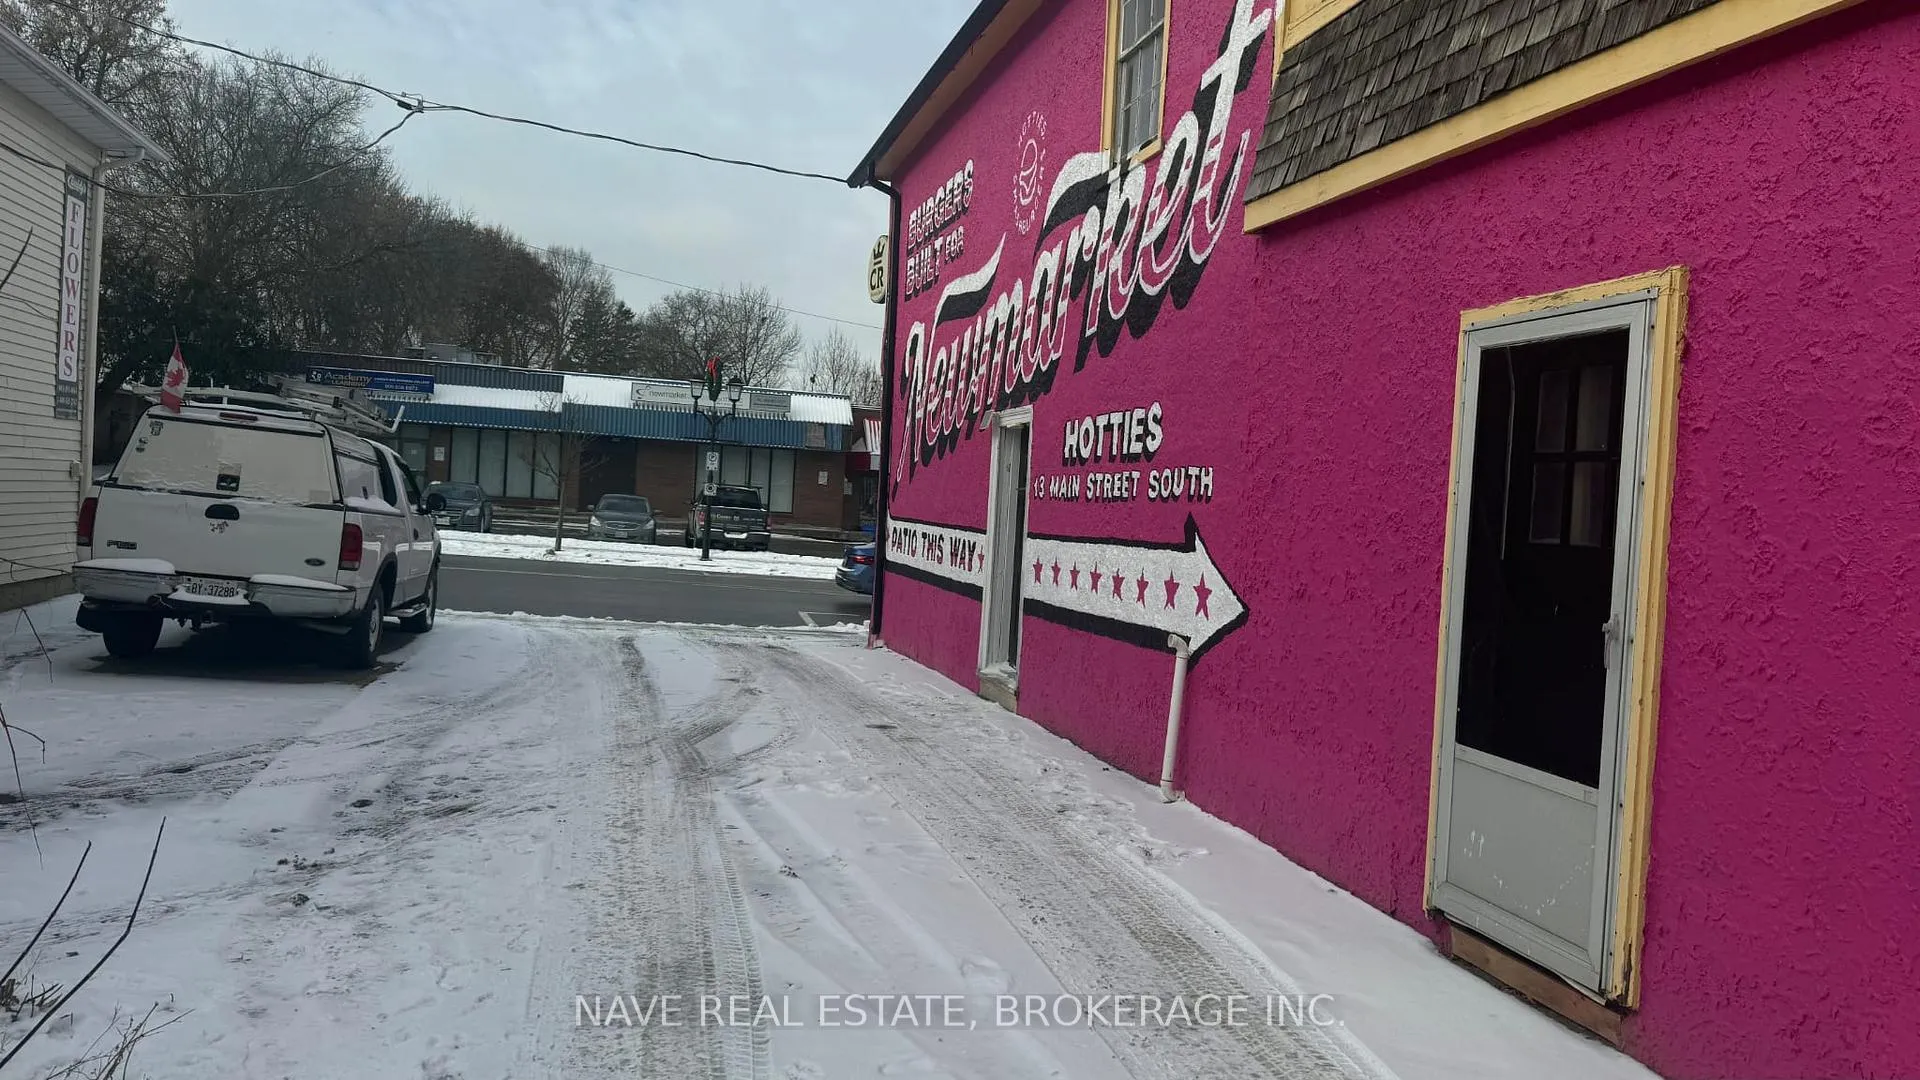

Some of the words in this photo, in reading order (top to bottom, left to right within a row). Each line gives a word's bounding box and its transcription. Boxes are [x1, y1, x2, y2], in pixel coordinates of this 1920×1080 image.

[906, 158, 975, 253] BURGERS
[896, 0, 1284, 490] Newmarket
[905, 236, 944, 300] BUILT
[944, 225, 965, 263] FOR
[63, 203, 81, 378] FLOWERS
[869, 265, 885, 291] CR
[324, 371, 373, 384] Academy
[1063, 401, 1164, 463] HOTTIES
[1050, 474, 1081, 500] MAIN
[1086, 471, 1141, 500] STREET
[1148, 466, 1214, 502] SOUTH
[891, 526, 918, 558] PATIO
[921, 532, 945, 565] THIS
[949, 536, 977, 572] WAY
